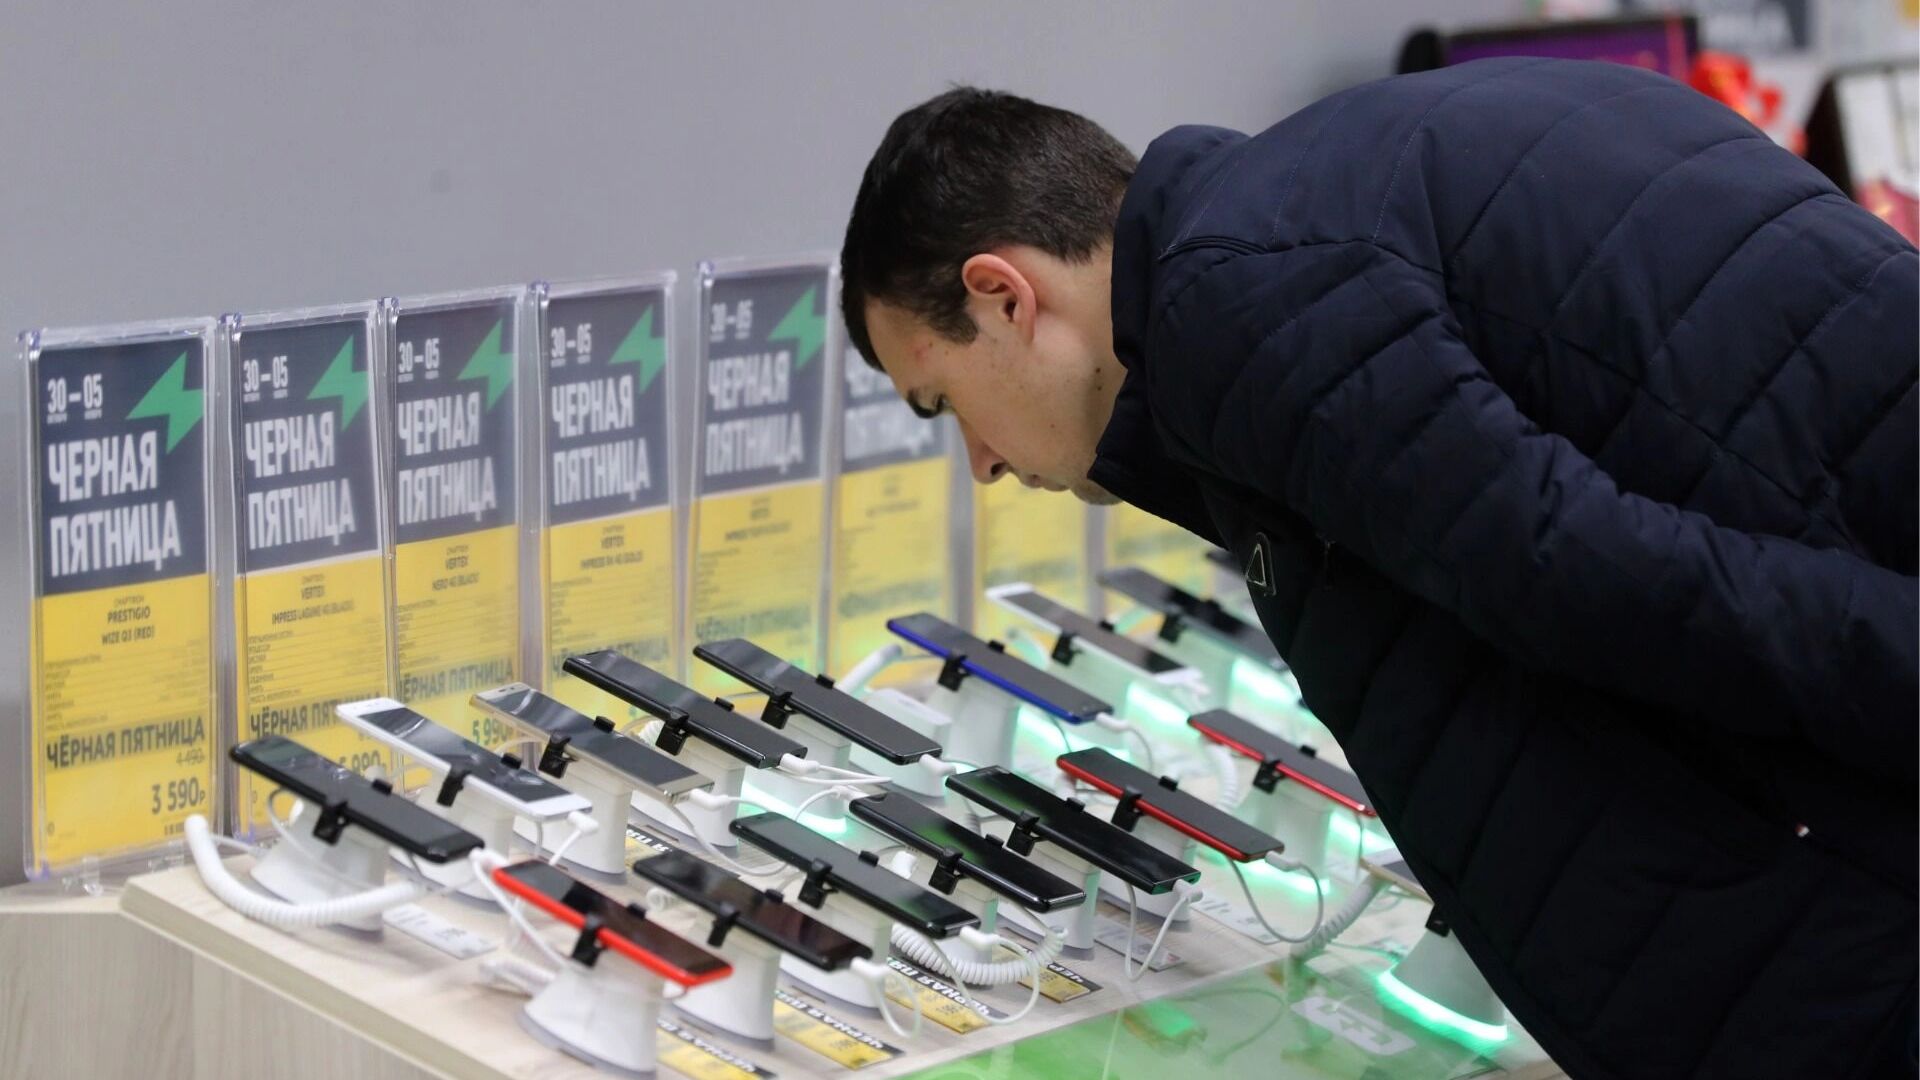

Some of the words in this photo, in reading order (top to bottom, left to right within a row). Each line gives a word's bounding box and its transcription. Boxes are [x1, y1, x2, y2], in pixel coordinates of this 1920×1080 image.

[398, 392, 480, 456] ЧЕРНАЯ
[551, 375, 634, 438] ЧЕРНАЯ
[48, 430, 157, 503] ЧЕРНАЯ
[245, 411, 335, 478] ЧЕРНАЯ
[553, 438, 650, 505] ПЯТНИЦА
[248, 478, 356, 550] ПЯТНИЦА
[399, 457, 497, 525] ПЯТНИЦА
[50, 500, 181, 577] ПЯТНИЦА
[107, 605, 151, 624] PRESTIGIO
[47, 732, 116, 769] ЧЁРНАЯ
[121, 716, 206, 755] ПЯТНИЦА
[250, 706, 308, 740] ЧЁРНАЯ
[151, 783, 162, 815] 3
